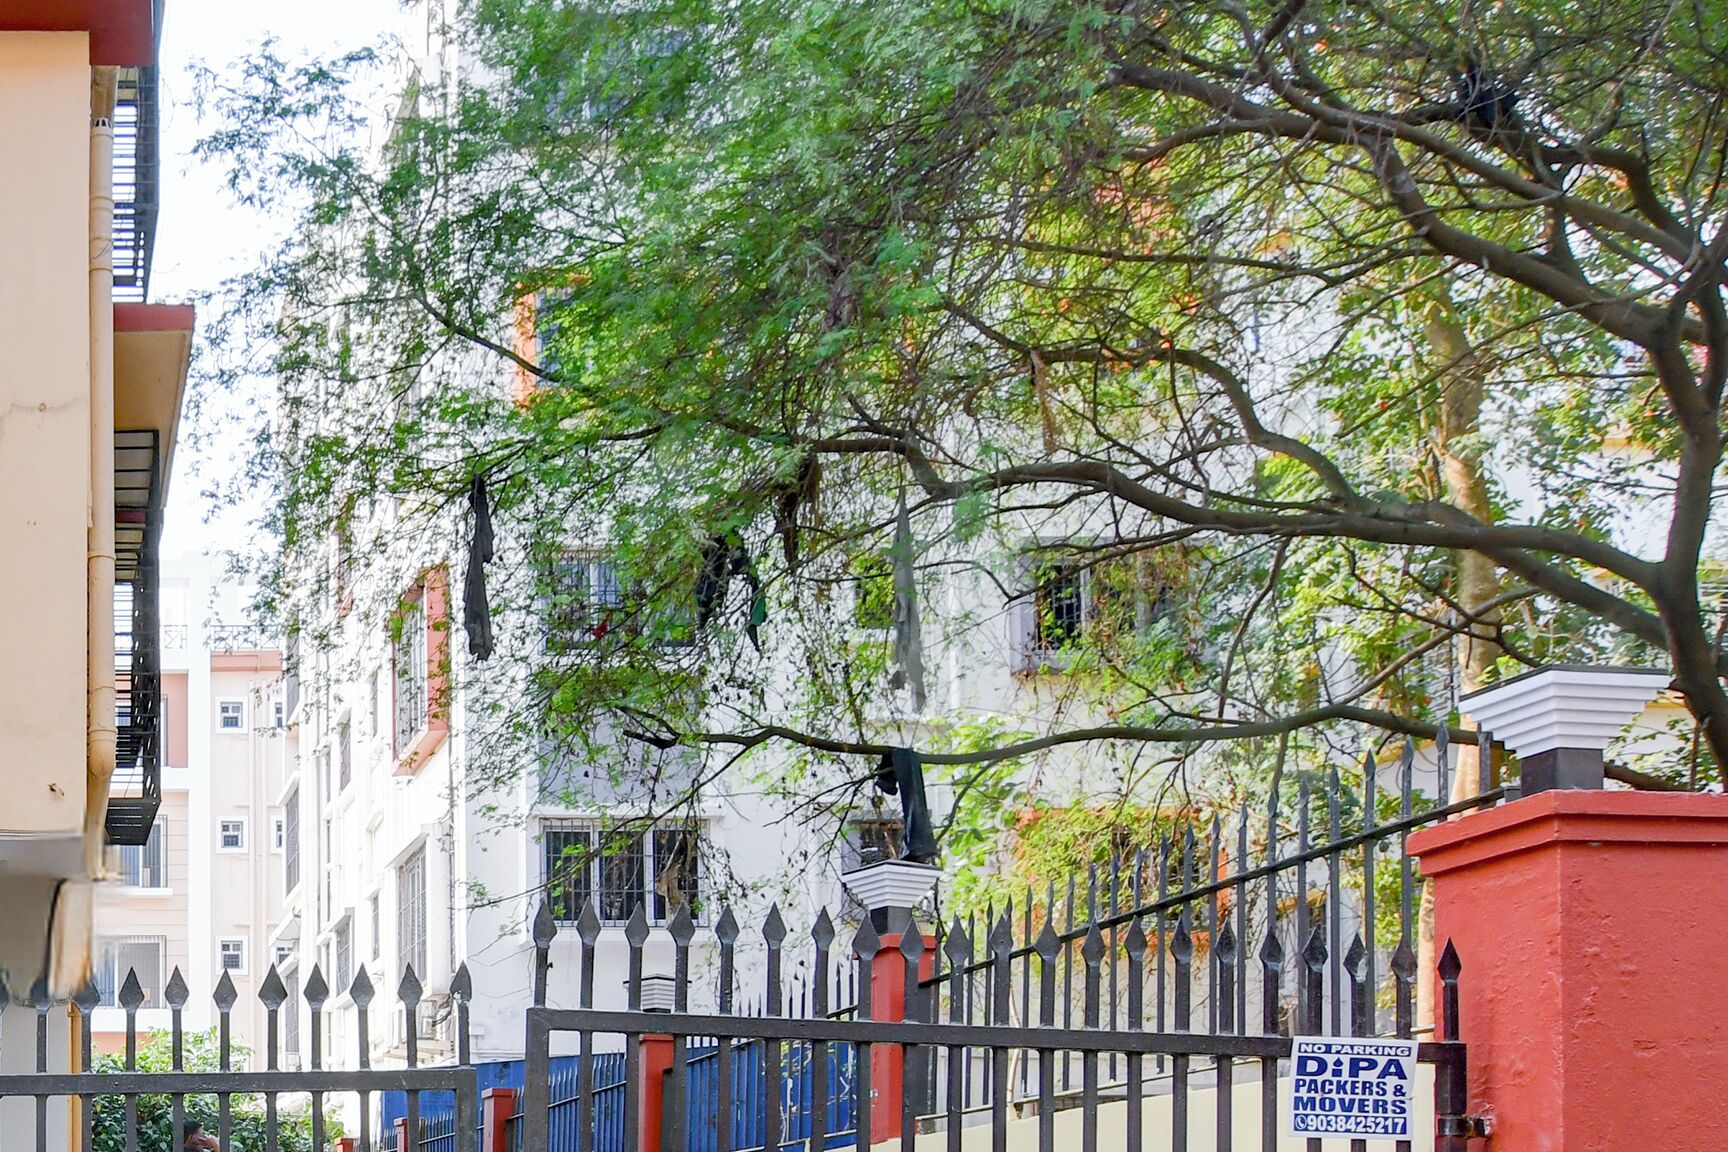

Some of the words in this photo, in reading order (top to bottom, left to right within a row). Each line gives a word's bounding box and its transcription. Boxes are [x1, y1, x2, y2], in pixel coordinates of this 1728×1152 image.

[1300, 1043, 1326, 1054] NO
[1330, 1045, 1410, 1056] PARKING
[1294, 1078, 1388, 1097] PACKERS
[1393, 1083, 1407, 1097] &
[1293, 1096, 1407, 1115] MOVERS
[1307, 1114, 1405, 1134] 9038425217
